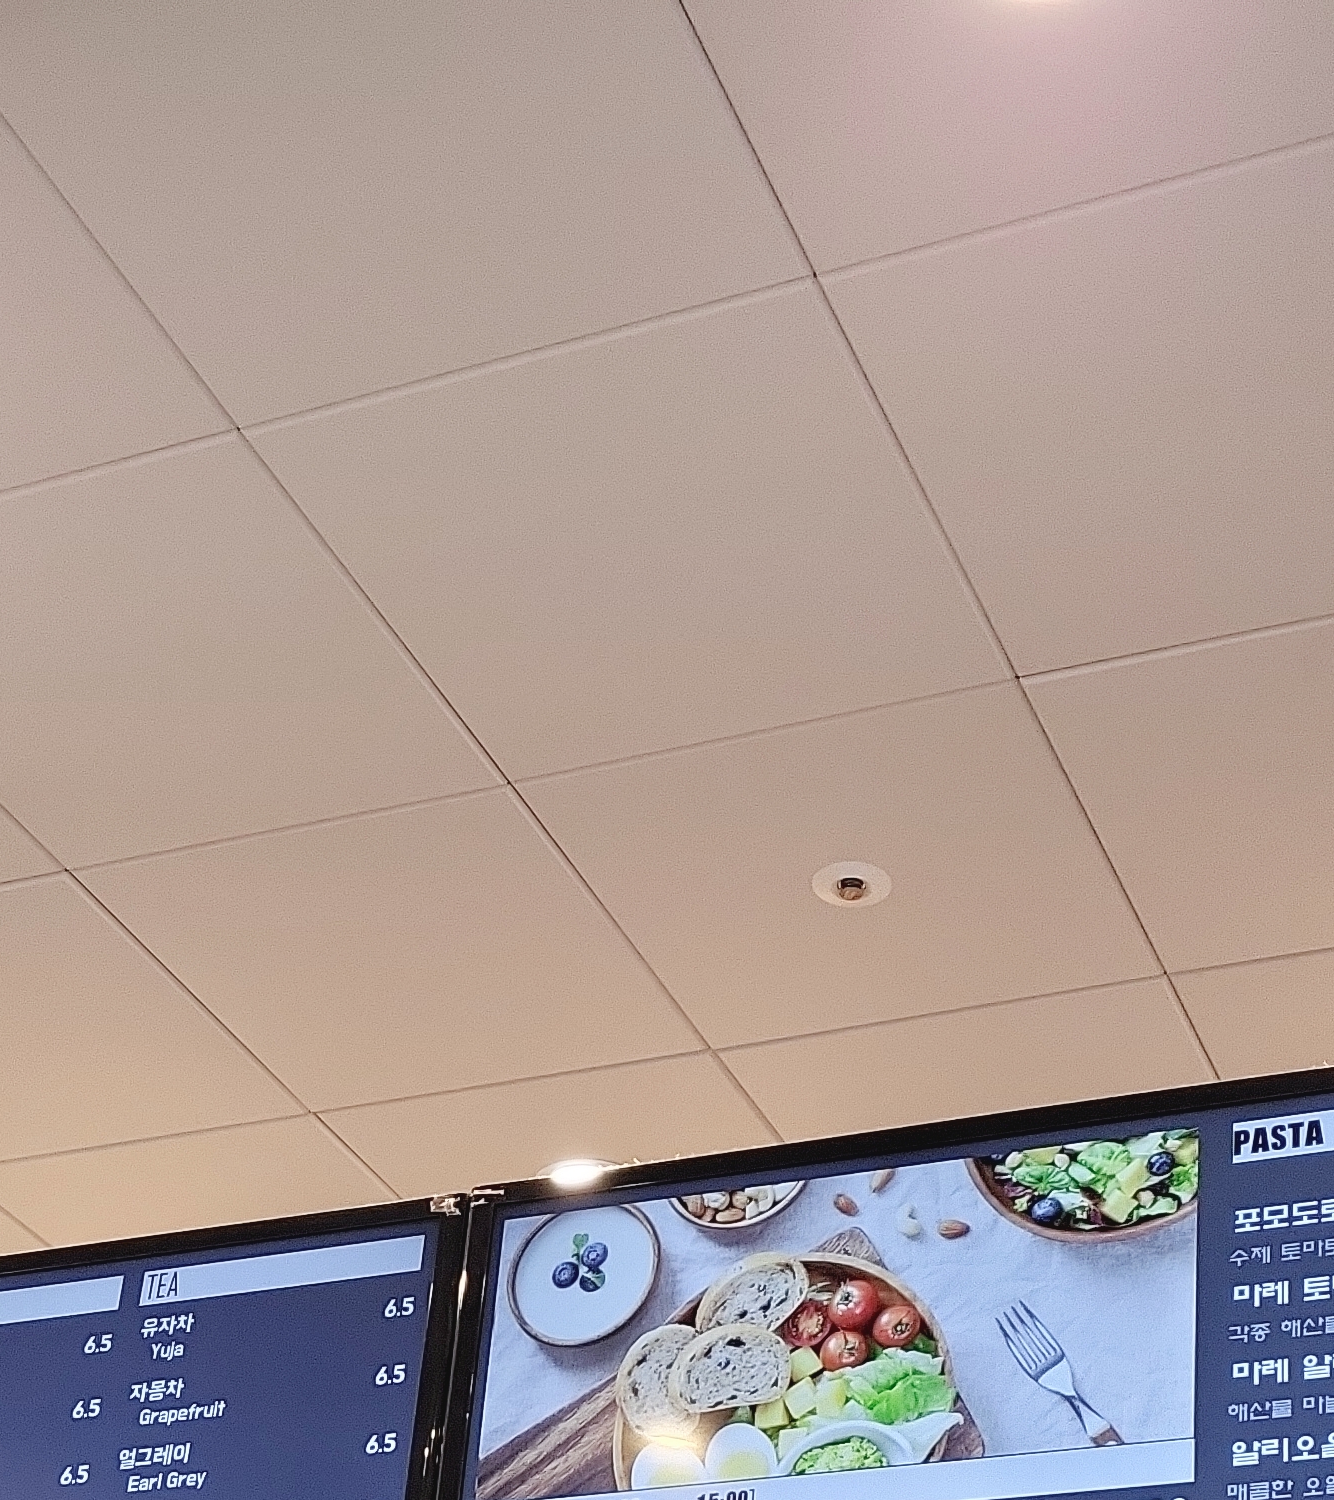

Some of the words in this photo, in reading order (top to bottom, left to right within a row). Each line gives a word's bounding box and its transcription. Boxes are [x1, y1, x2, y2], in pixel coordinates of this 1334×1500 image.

[1234, 1120, 1323, 1155] PASTA
[1230, 1246, 1270, 1266] 수제
[148, 1272, 177, 1299] TEA
[1234, 1281, 1288, 1307] 마레
[385, 1297, 414, 1317] 6.5
[141, 1313, 194, 1337] 유자차
[84, 1334, 112, 1353] 6.5
[152, 1342, 183, 1360] Yuja
[376, 1365, 405, 1385] 6.5
[1233, 1359, 1288, 1385] 마레
[130, 1379, 184, 1402] 자몽차
[73, 1399, 101, 1418] 6.5
[140, 1401, 225, 1425] Grapefruit
[366, 1433, 396, 1453] 6.5
[120, 1443, 190, 1469] 얼그레이
[61, 1465, 89, 1484] 6.5
[128, 1473, 162, 1492] Earl
[167, 1472, 206, 1488] Grey
